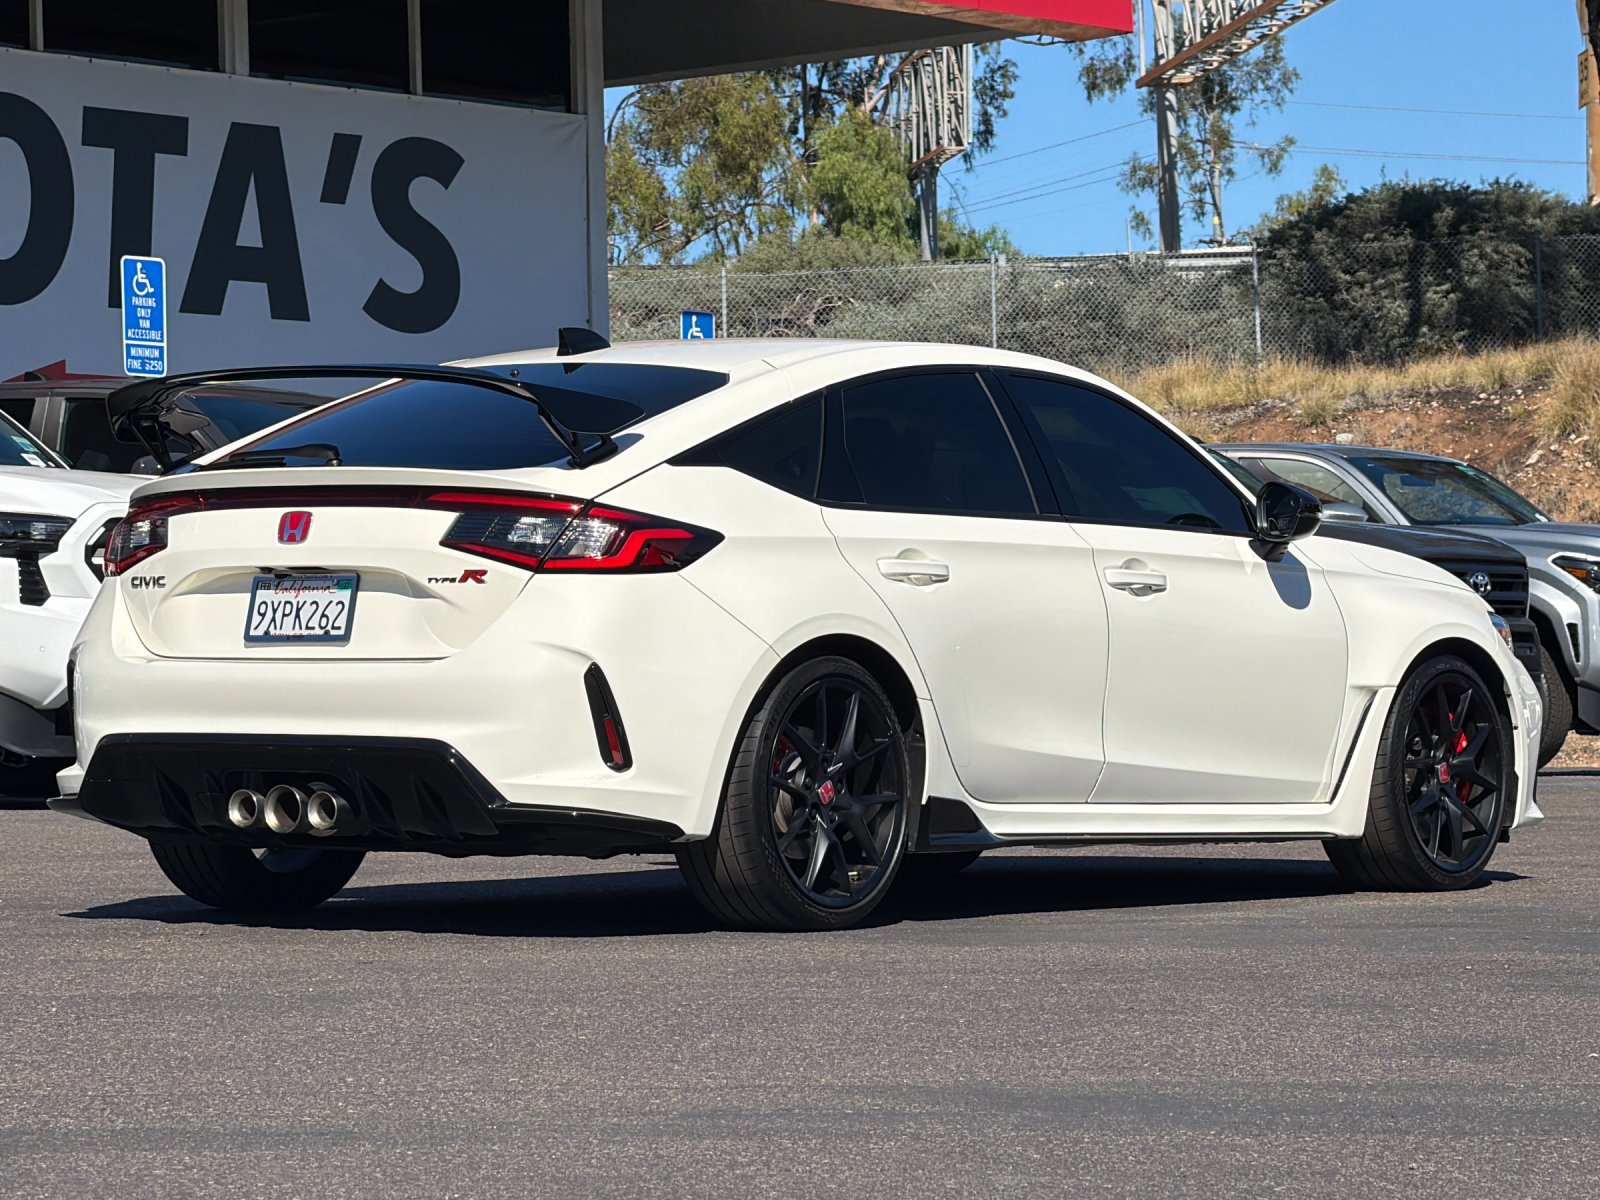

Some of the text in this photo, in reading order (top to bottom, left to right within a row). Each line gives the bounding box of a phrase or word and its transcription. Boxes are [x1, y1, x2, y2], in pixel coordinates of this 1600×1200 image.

[132, 296, 156, 307] PARKING
[137, 308, 151, 318] ONLY
[139, 319, 150, 329] VAN
[127, 329, 162, 341] ACCESSIBLE
[130, 346, 160, 359] MINIMUM
[128, 359, 162, 372] FINE $250
[131, 575, 166, 589] CIVIC
[458, 569, 488, 584] R
[273, 579, 336, 599] California
[253, 600, 346, 631] 9XPK262
